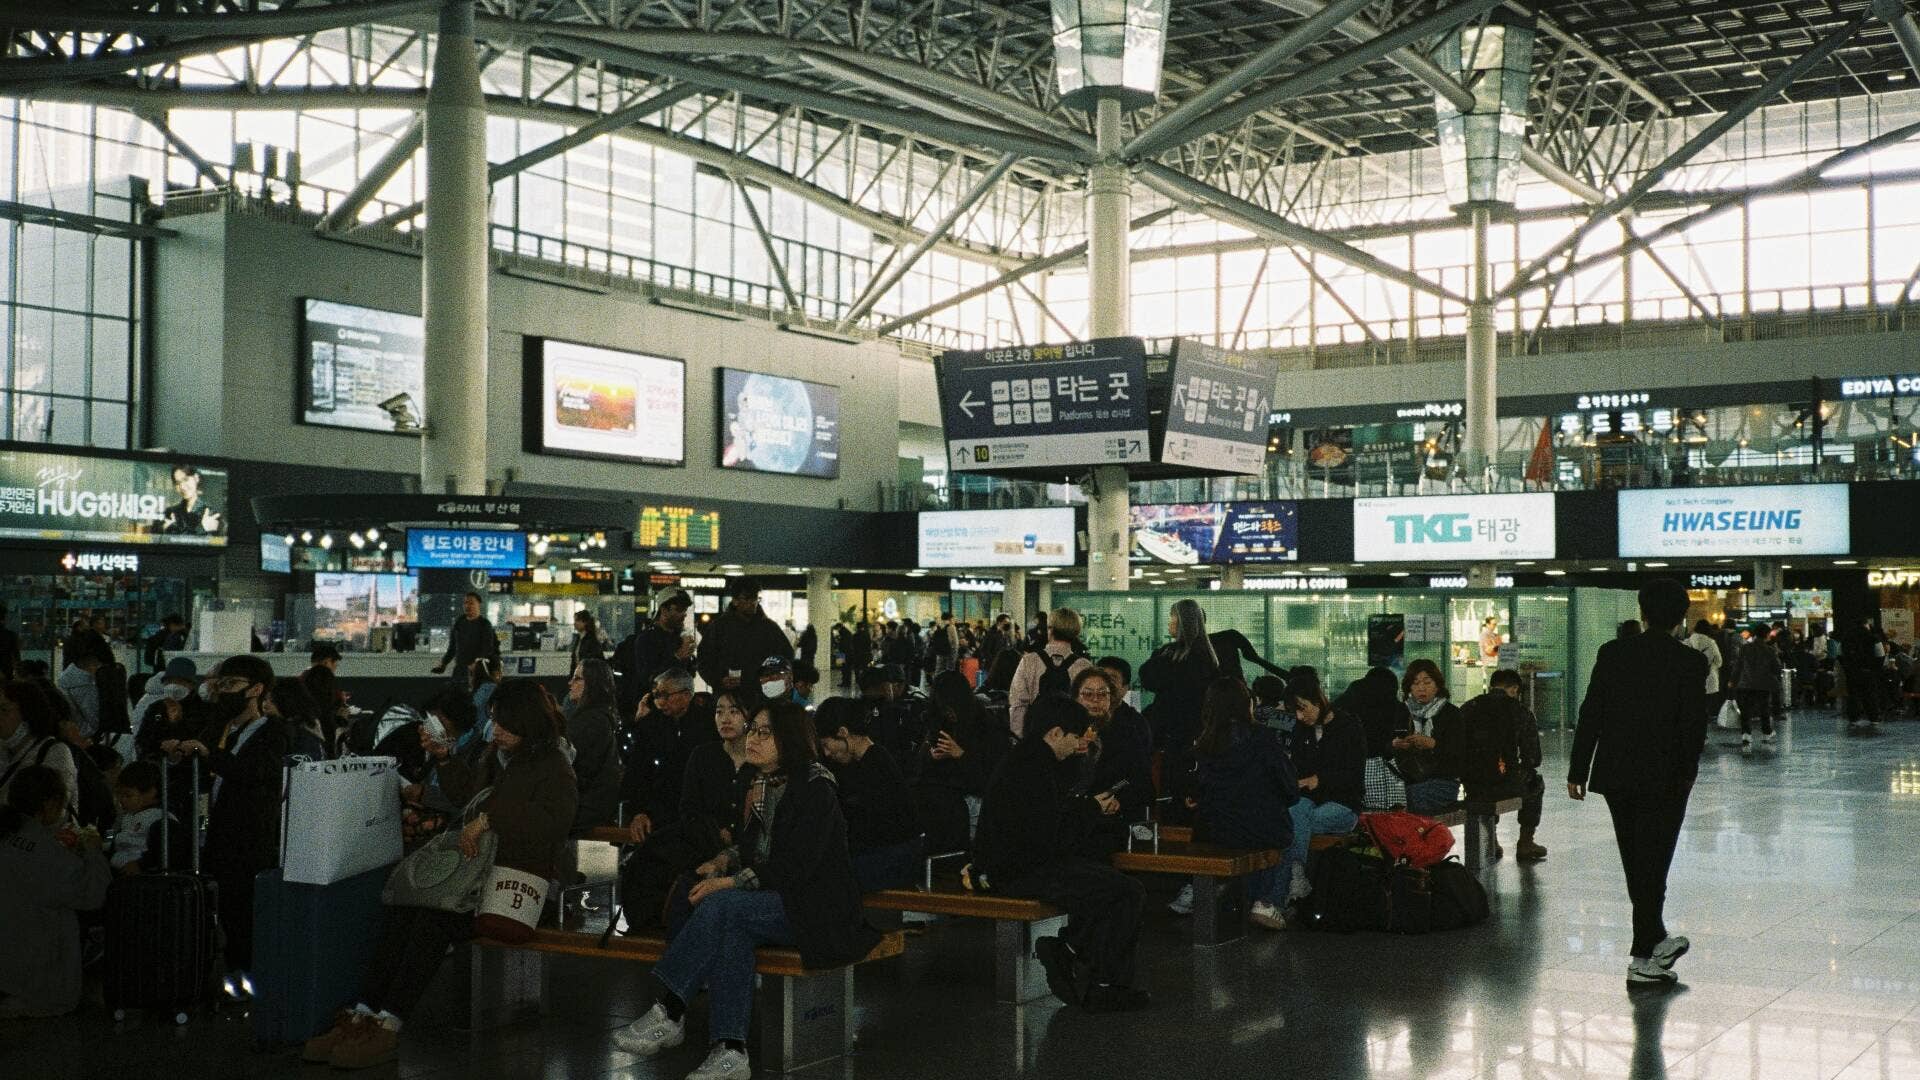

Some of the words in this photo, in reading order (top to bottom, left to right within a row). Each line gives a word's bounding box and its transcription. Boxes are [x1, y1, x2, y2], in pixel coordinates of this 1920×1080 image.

[1065, 343, 1096, 358] 입니다
[1056, 374, 1099, 402] 타는
[1108, 372, 1130, 400] 곳
[1211, 381, 1232, 409] 타는
[1842, 379, 1895, 395] EDIYA
[1059, 410, 1093, 420] Platforms
[1560, 410, 1673, 435] 푸드코트
[976, 447, 988, 460] 10
[38, 489, 165, 520] HUG하세요!
[437, 502, 481, 514] KORAIL
[485, 503, 521, 514] 부산역
[1385, 513, 1473, 544] TKG
[1477, 518, 1520, 543] 태광
[1662, 509, 1802, 533] HWASEUNG
[421, 535, 514, 552] 철도이용안내
[77, 554, 138, 571] 새부산약국
[1309, 578, 1348, 590] COFFEE
[1430, 577, 1468, 588] KAKAO
[495, 880, 519, 892] RED
[520, 882, 542, 906] SOX
[510, 892, 524, 910] B
